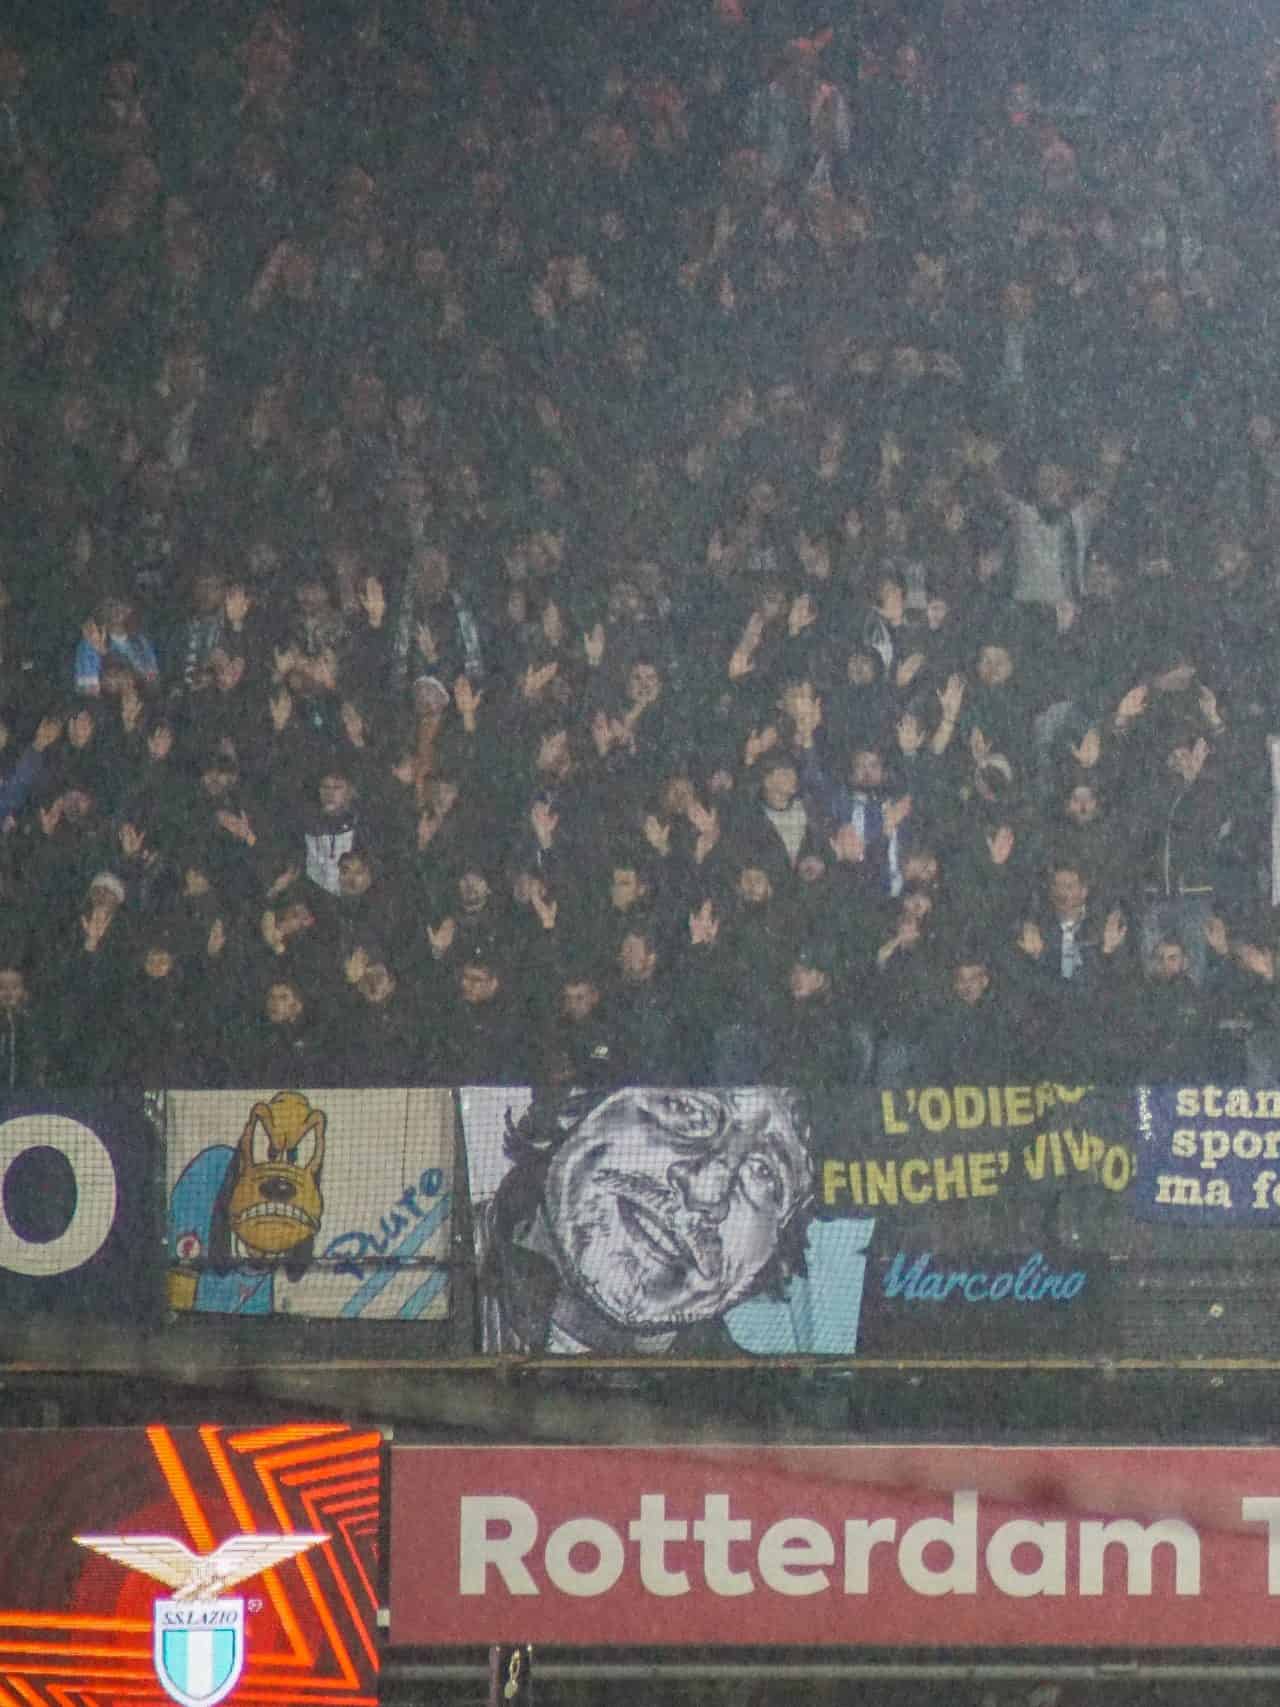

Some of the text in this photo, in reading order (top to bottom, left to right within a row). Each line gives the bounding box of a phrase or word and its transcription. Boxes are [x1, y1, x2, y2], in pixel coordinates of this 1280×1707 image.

[823, 1150, 1009, 1205] FINCHE'
[1155, 1175, 1233, 1207] ma
[883, 1251, 1088, 1301] Marcolino
[459, 1491, 1201, 1598] Rotterdam
